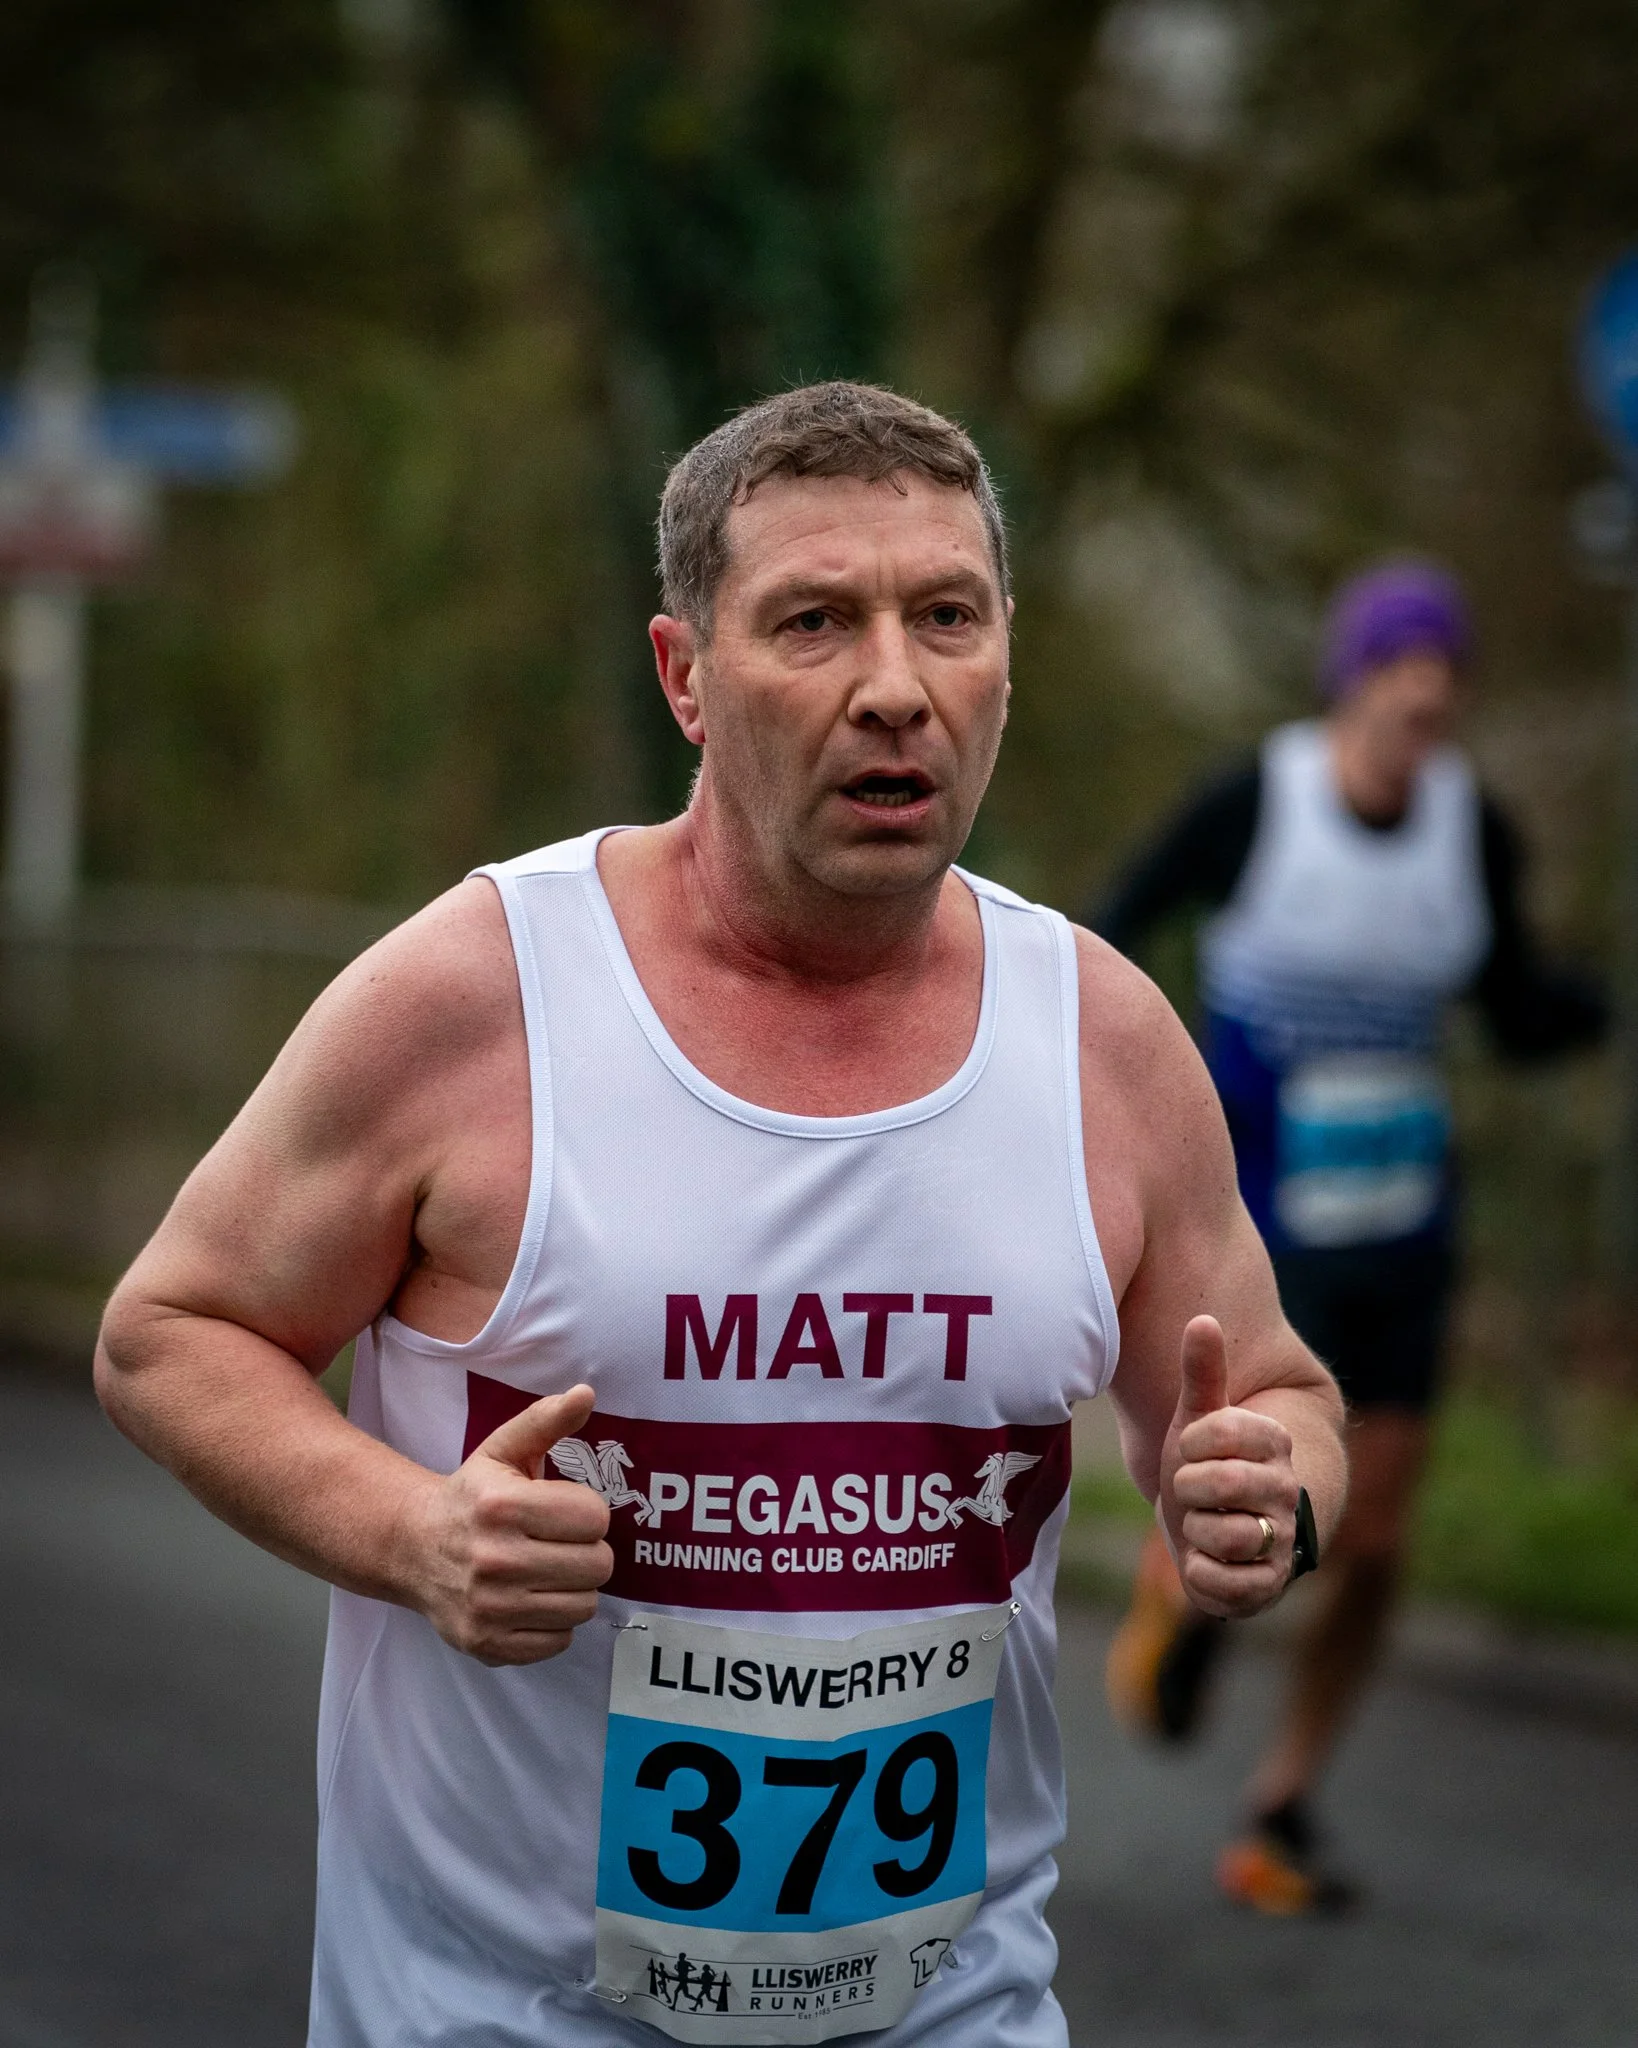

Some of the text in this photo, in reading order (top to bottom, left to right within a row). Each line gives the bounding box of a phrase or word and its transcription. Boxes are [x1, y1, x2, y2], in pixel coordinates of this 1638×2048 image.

[664, 1293, 993, 1381] MATT
[648, 1472, 953, 1535] PEGASUS
[634, 1539, 956, 1573] RUNNING CLUB CARDIFF
[650, 1640, 971, 1709] LLISWERRY 8
[627, 1731, 959, 1915] 379
[750, 1982, 875, 2010] RUNNERS
[752, 1955, 878, 1989] LLISWERRY
